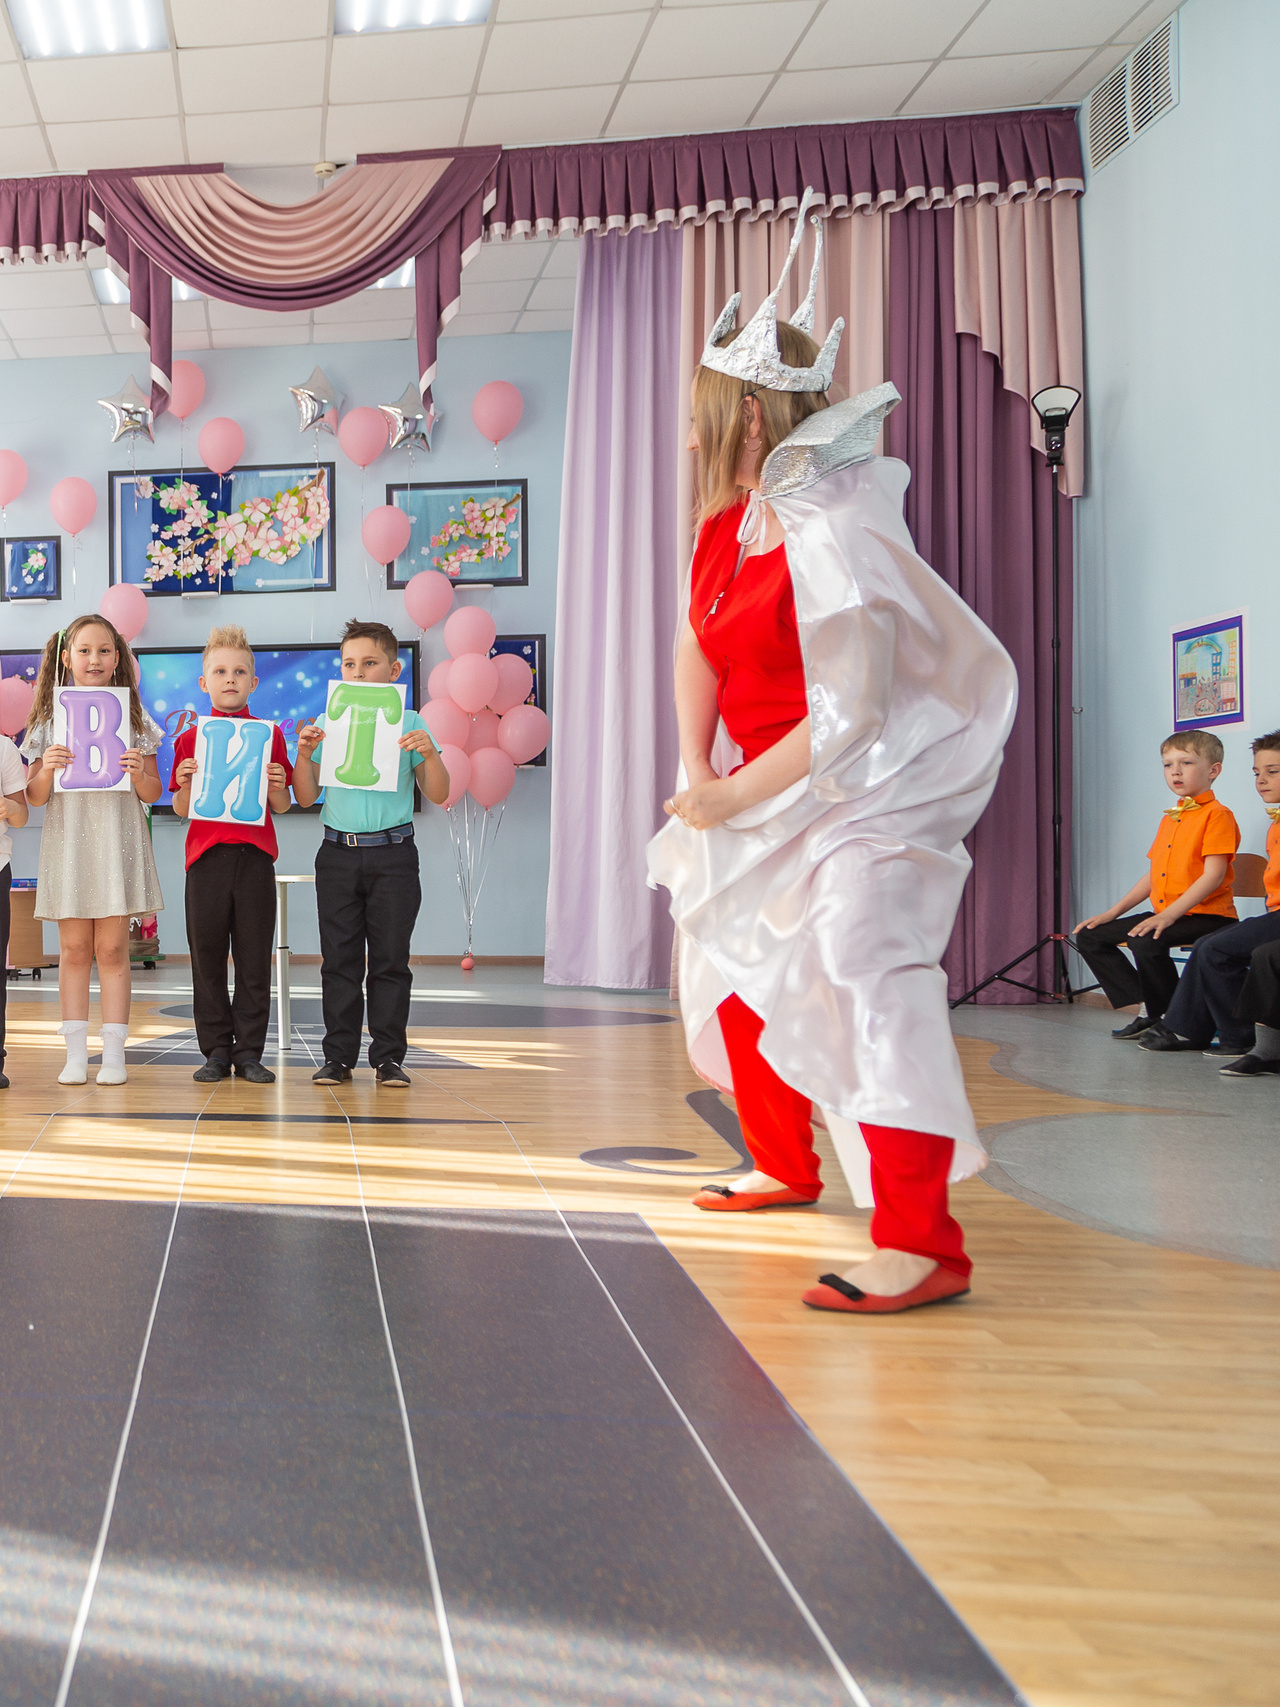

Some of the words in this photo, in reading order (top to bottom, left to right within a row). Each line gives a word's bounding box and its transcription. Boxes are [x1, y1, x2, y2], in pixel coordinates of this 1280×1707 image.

[59, 690, 127, 789] В
[194, 719, 272, 822] И
[328, 683, 403, 786] Т
